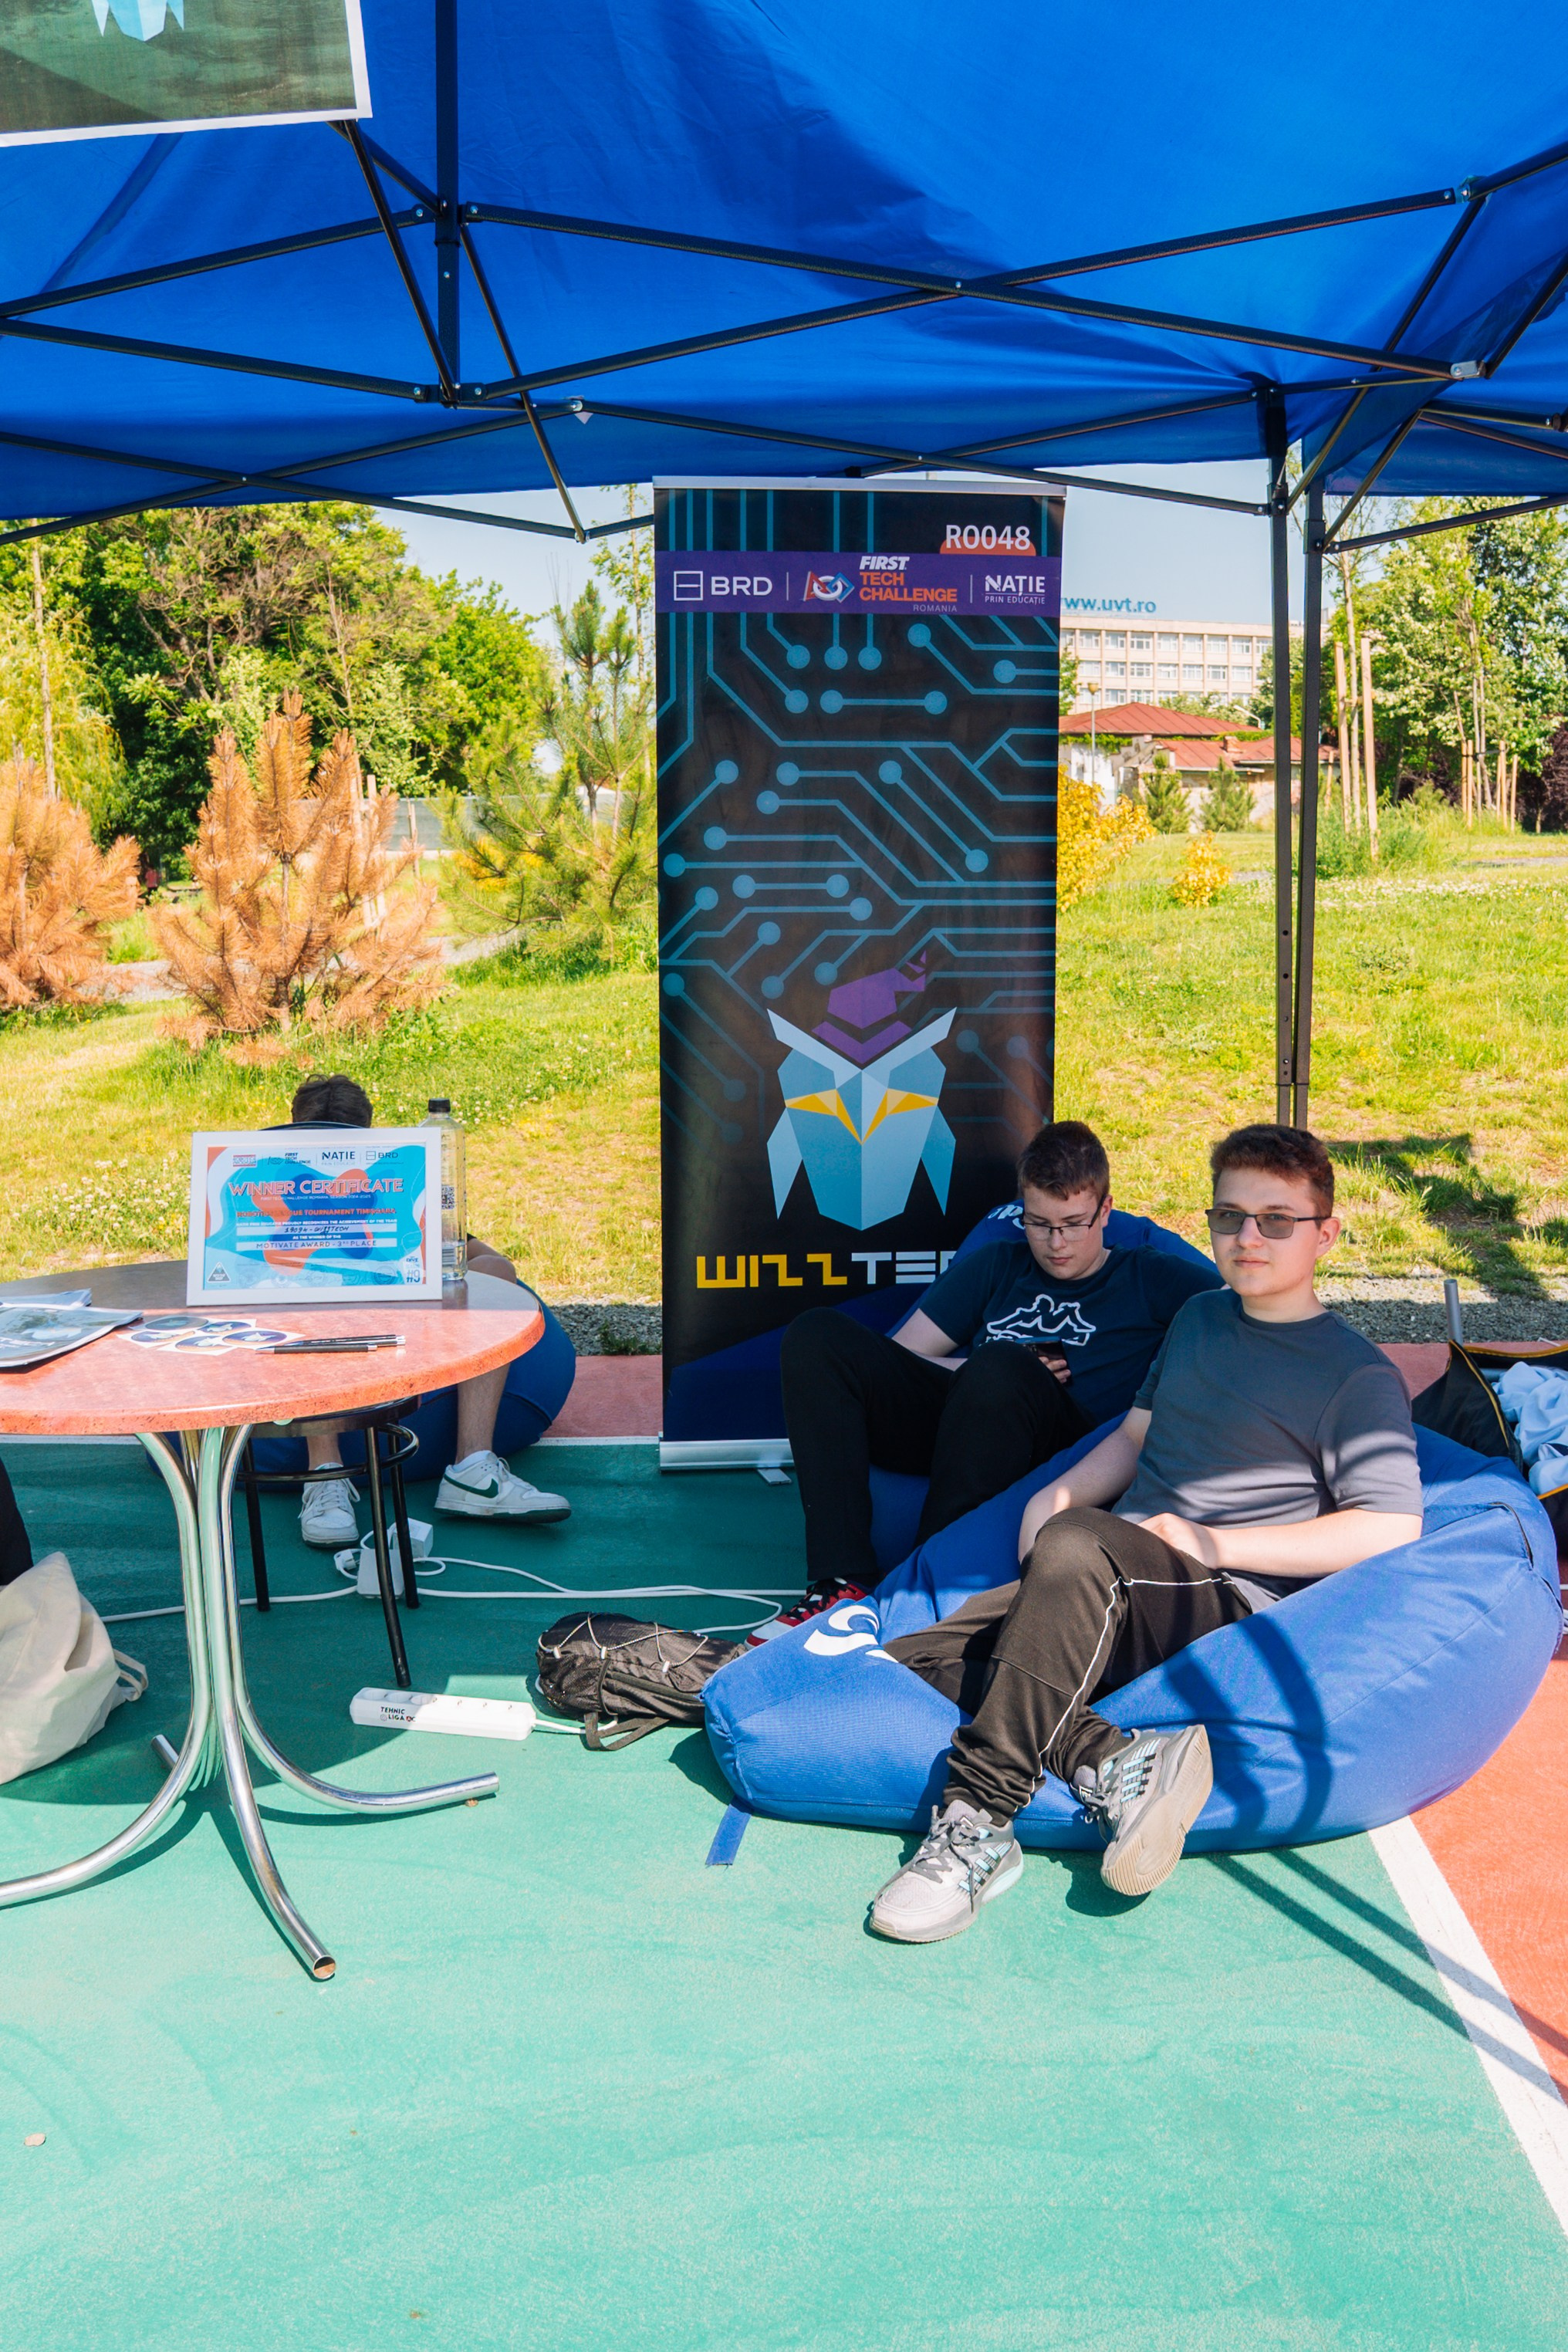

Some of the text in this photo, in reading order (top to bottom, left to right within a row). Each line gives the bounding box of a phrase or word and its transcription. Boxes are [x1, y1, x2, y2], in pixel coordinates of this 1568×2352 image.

[859, 556, 910, 570] FIRST
[711, 576, 772, 596] BRD
[860, 572, 904, 586] TECH
[859, 587, 958, 602] CHALLENGE
[1062, 597, 1157, 613] ww.uvt.ro
[228, 1178, 404, 1196] WINNER CERTIFICATE
